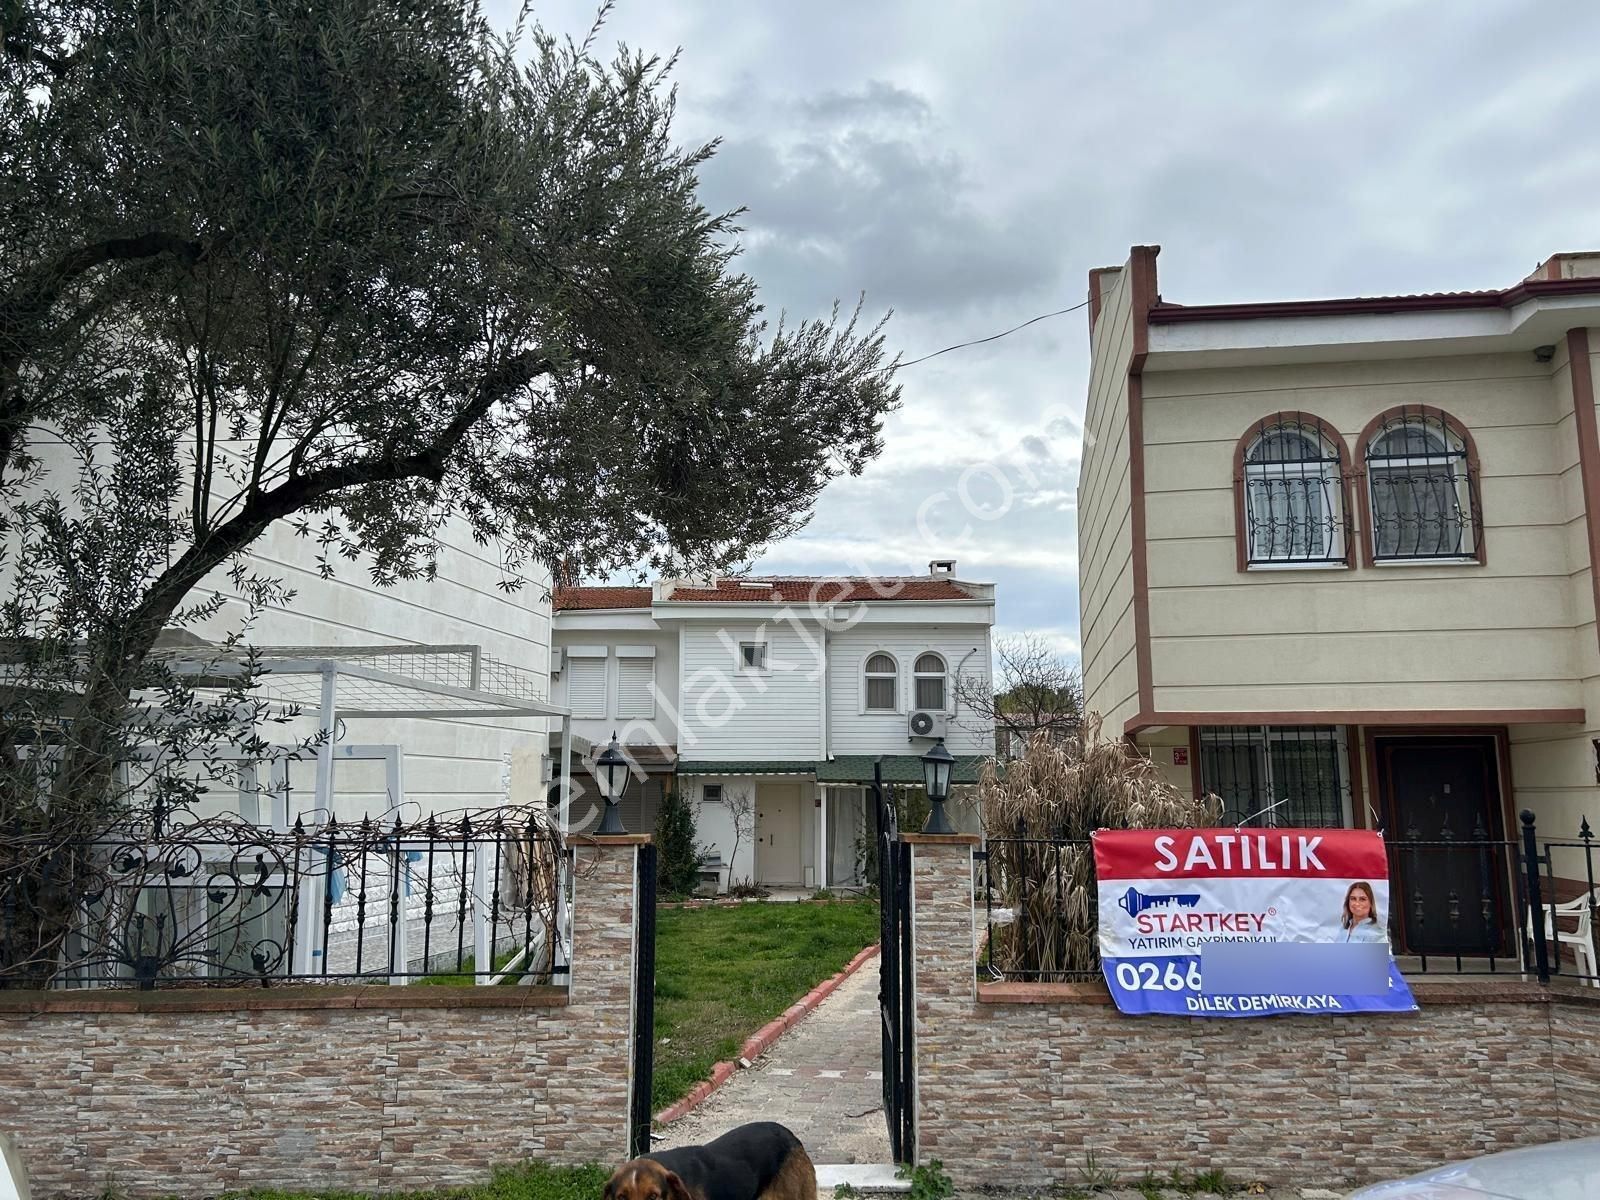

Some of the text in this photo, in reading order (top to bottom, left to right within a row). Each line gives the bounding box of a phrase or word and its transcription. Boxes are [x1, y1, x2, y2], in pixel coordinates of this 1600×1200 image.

[1154, 835, 1327, 872] SATILIK
[1137, 913, 1266, 934] STARTKEY
[1128, 936, 1183, 950] YATIRIM
[1186, 994, 1342, 1011] DİLEK DEMİRKAYA
